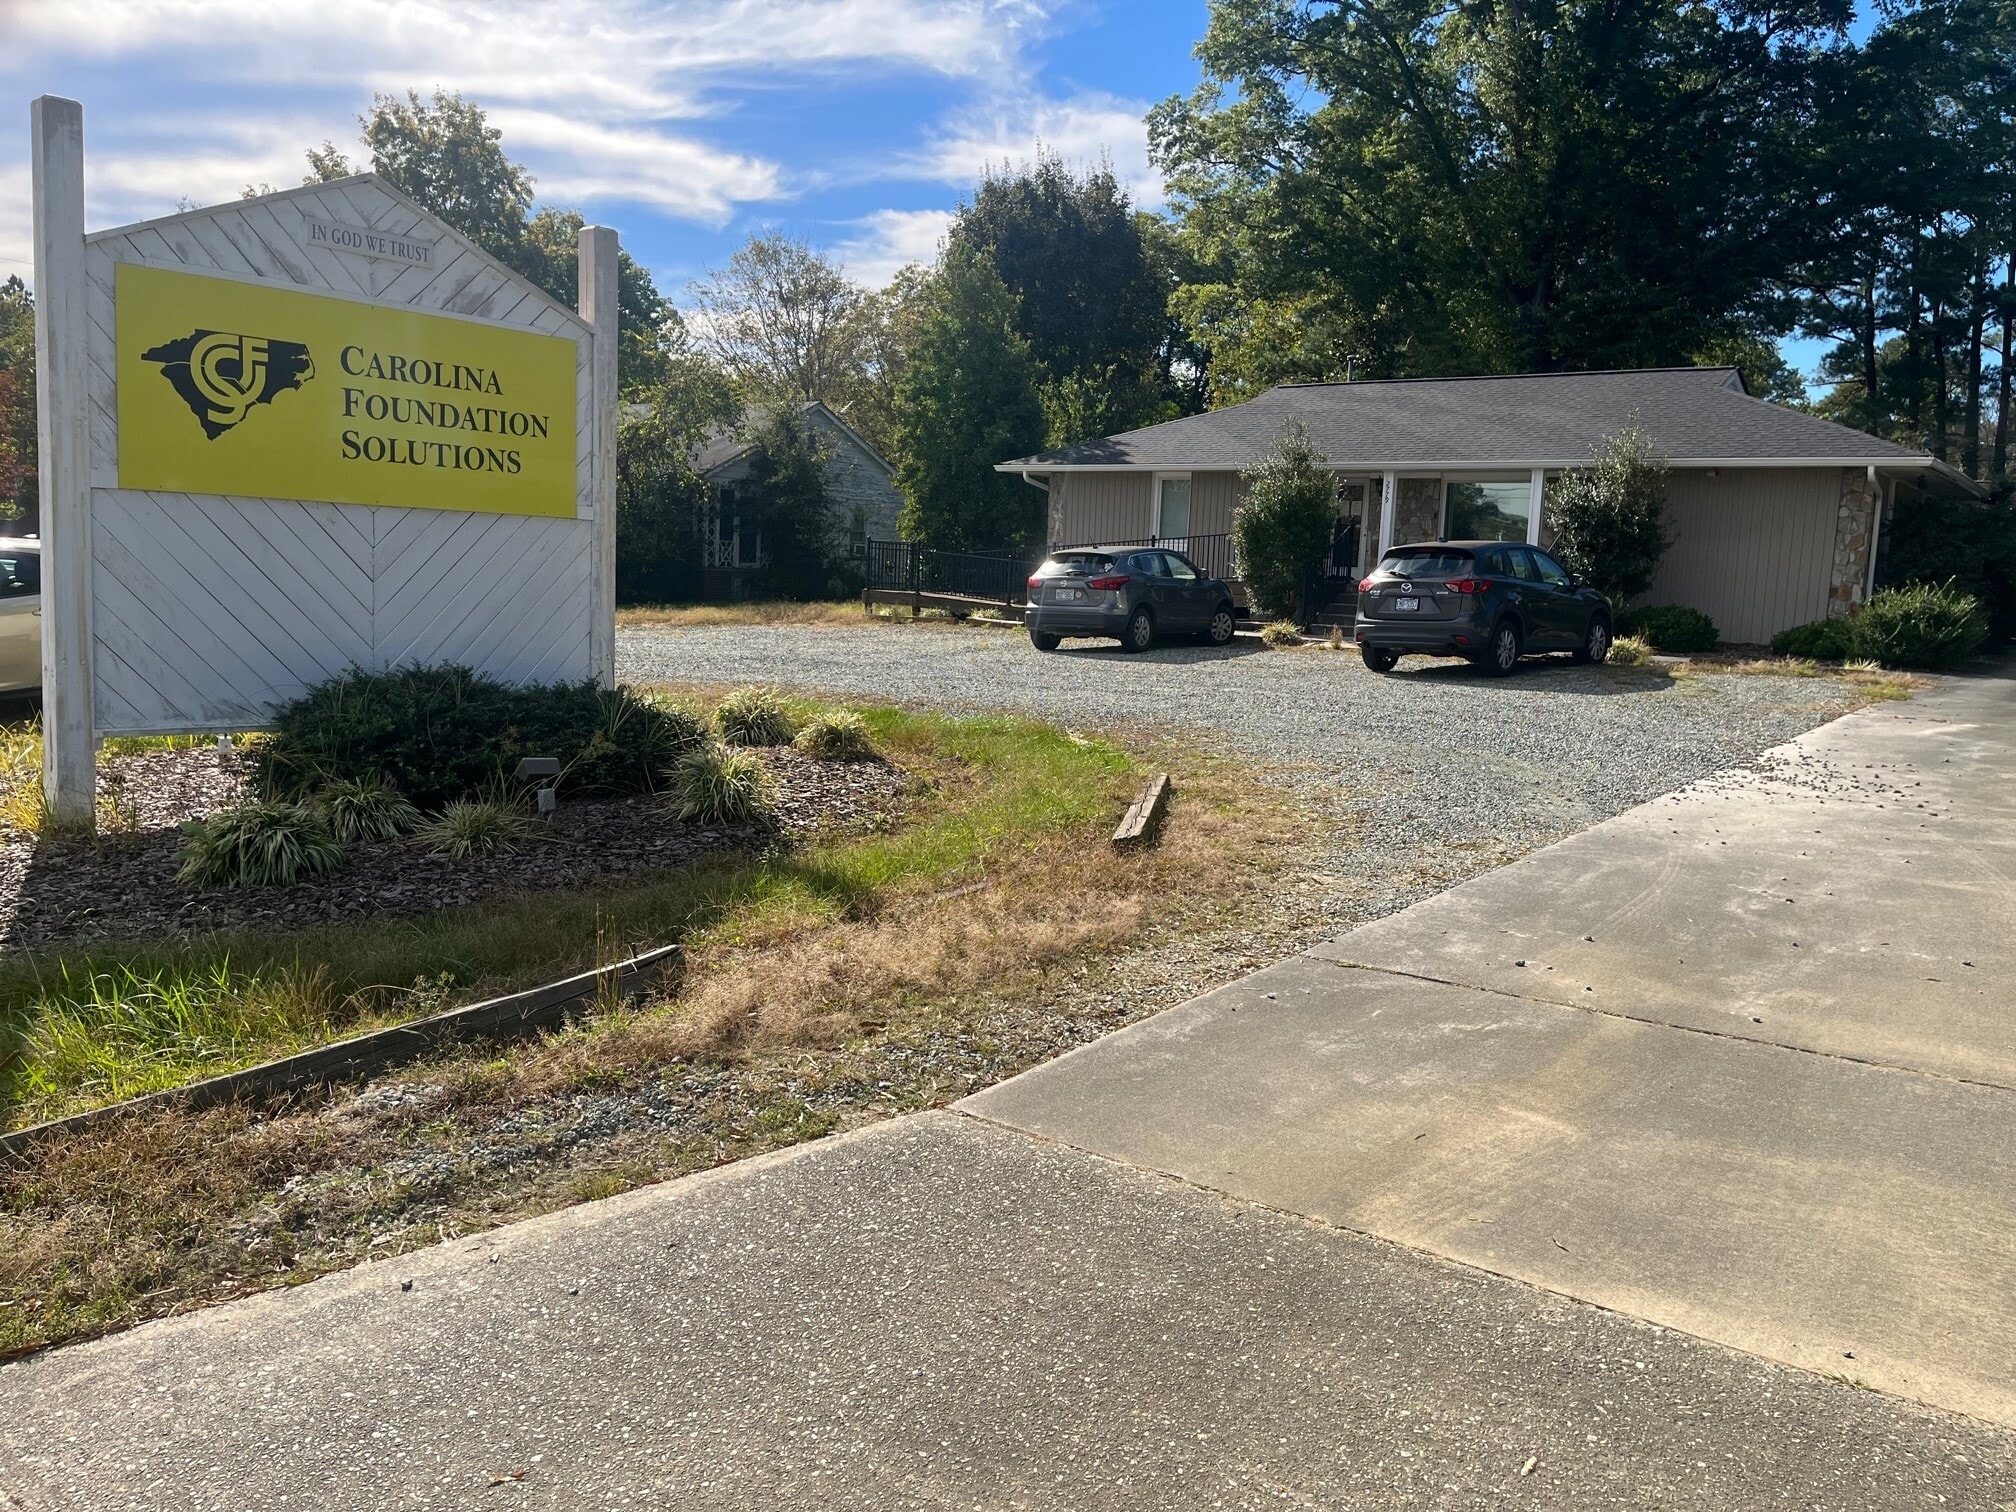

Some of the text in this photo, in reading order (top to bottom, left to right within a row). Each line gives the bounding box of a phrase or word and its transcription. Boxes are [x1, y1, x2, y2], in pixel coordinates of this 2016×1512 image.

[311, 223, 430, 262] IN GOD WE TRUST
[340, 345, 504, 395] CAROLINA
[341, 387, 550, 439] FOUNDATION
[341, 429, 521, 474] SOLUTIONS
